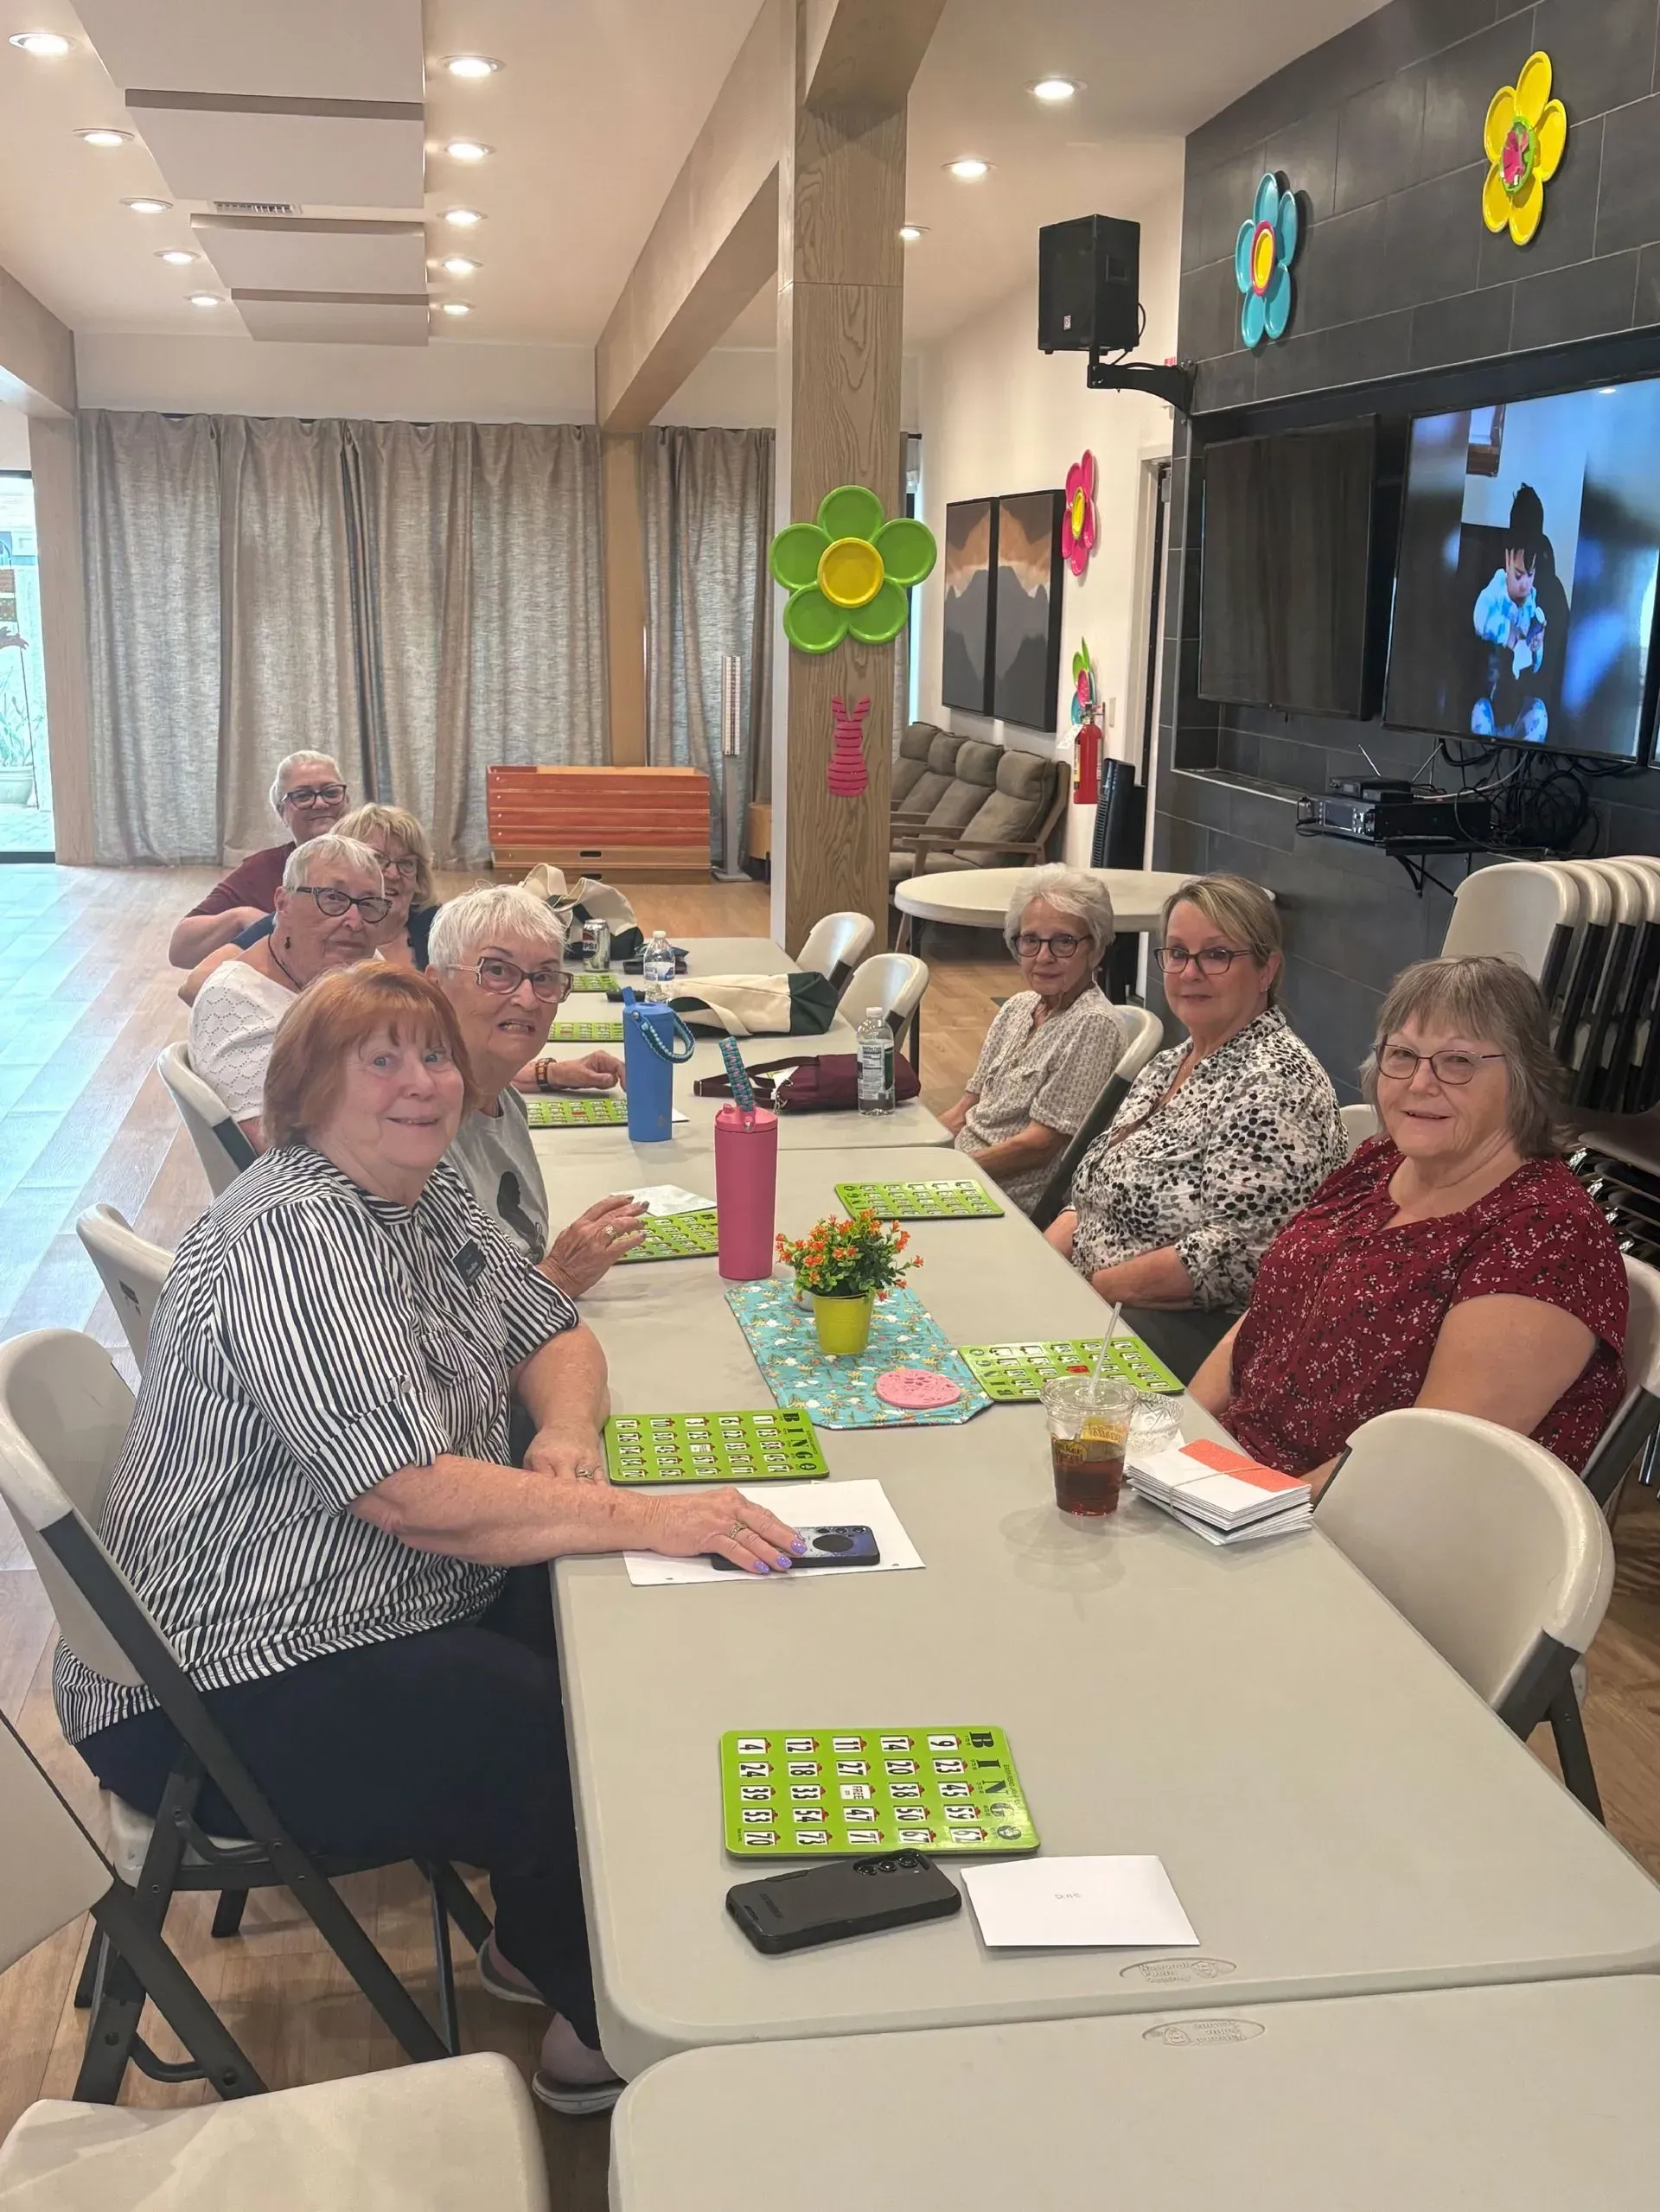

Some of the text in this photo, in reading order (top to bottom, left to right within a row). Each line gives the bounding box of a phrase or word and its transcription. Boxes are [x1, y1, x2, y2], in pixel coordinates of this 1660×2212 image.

[741, 1764, 766, 1777] 24
[935, 1761, 961, 1774] 23
[835, 1741, 877, 1844] 11 27 FREE 47 71
[882, 1739, 929, 1843] 14 20 38 50 67
[942, 1785, 967, 1797] 45
[969, 1731, 1022, 1841] BINGO
[743, 1788, 769, 1800] 39
[787, 1741, 825, 1845] 12 18 33 54 73
[744, 1811, 770, 1823] 53
[947, 1807, 974, 1820] 59
[747, 1833, 774, 1845] 70
[953, 1830, 980, 1842] 62
